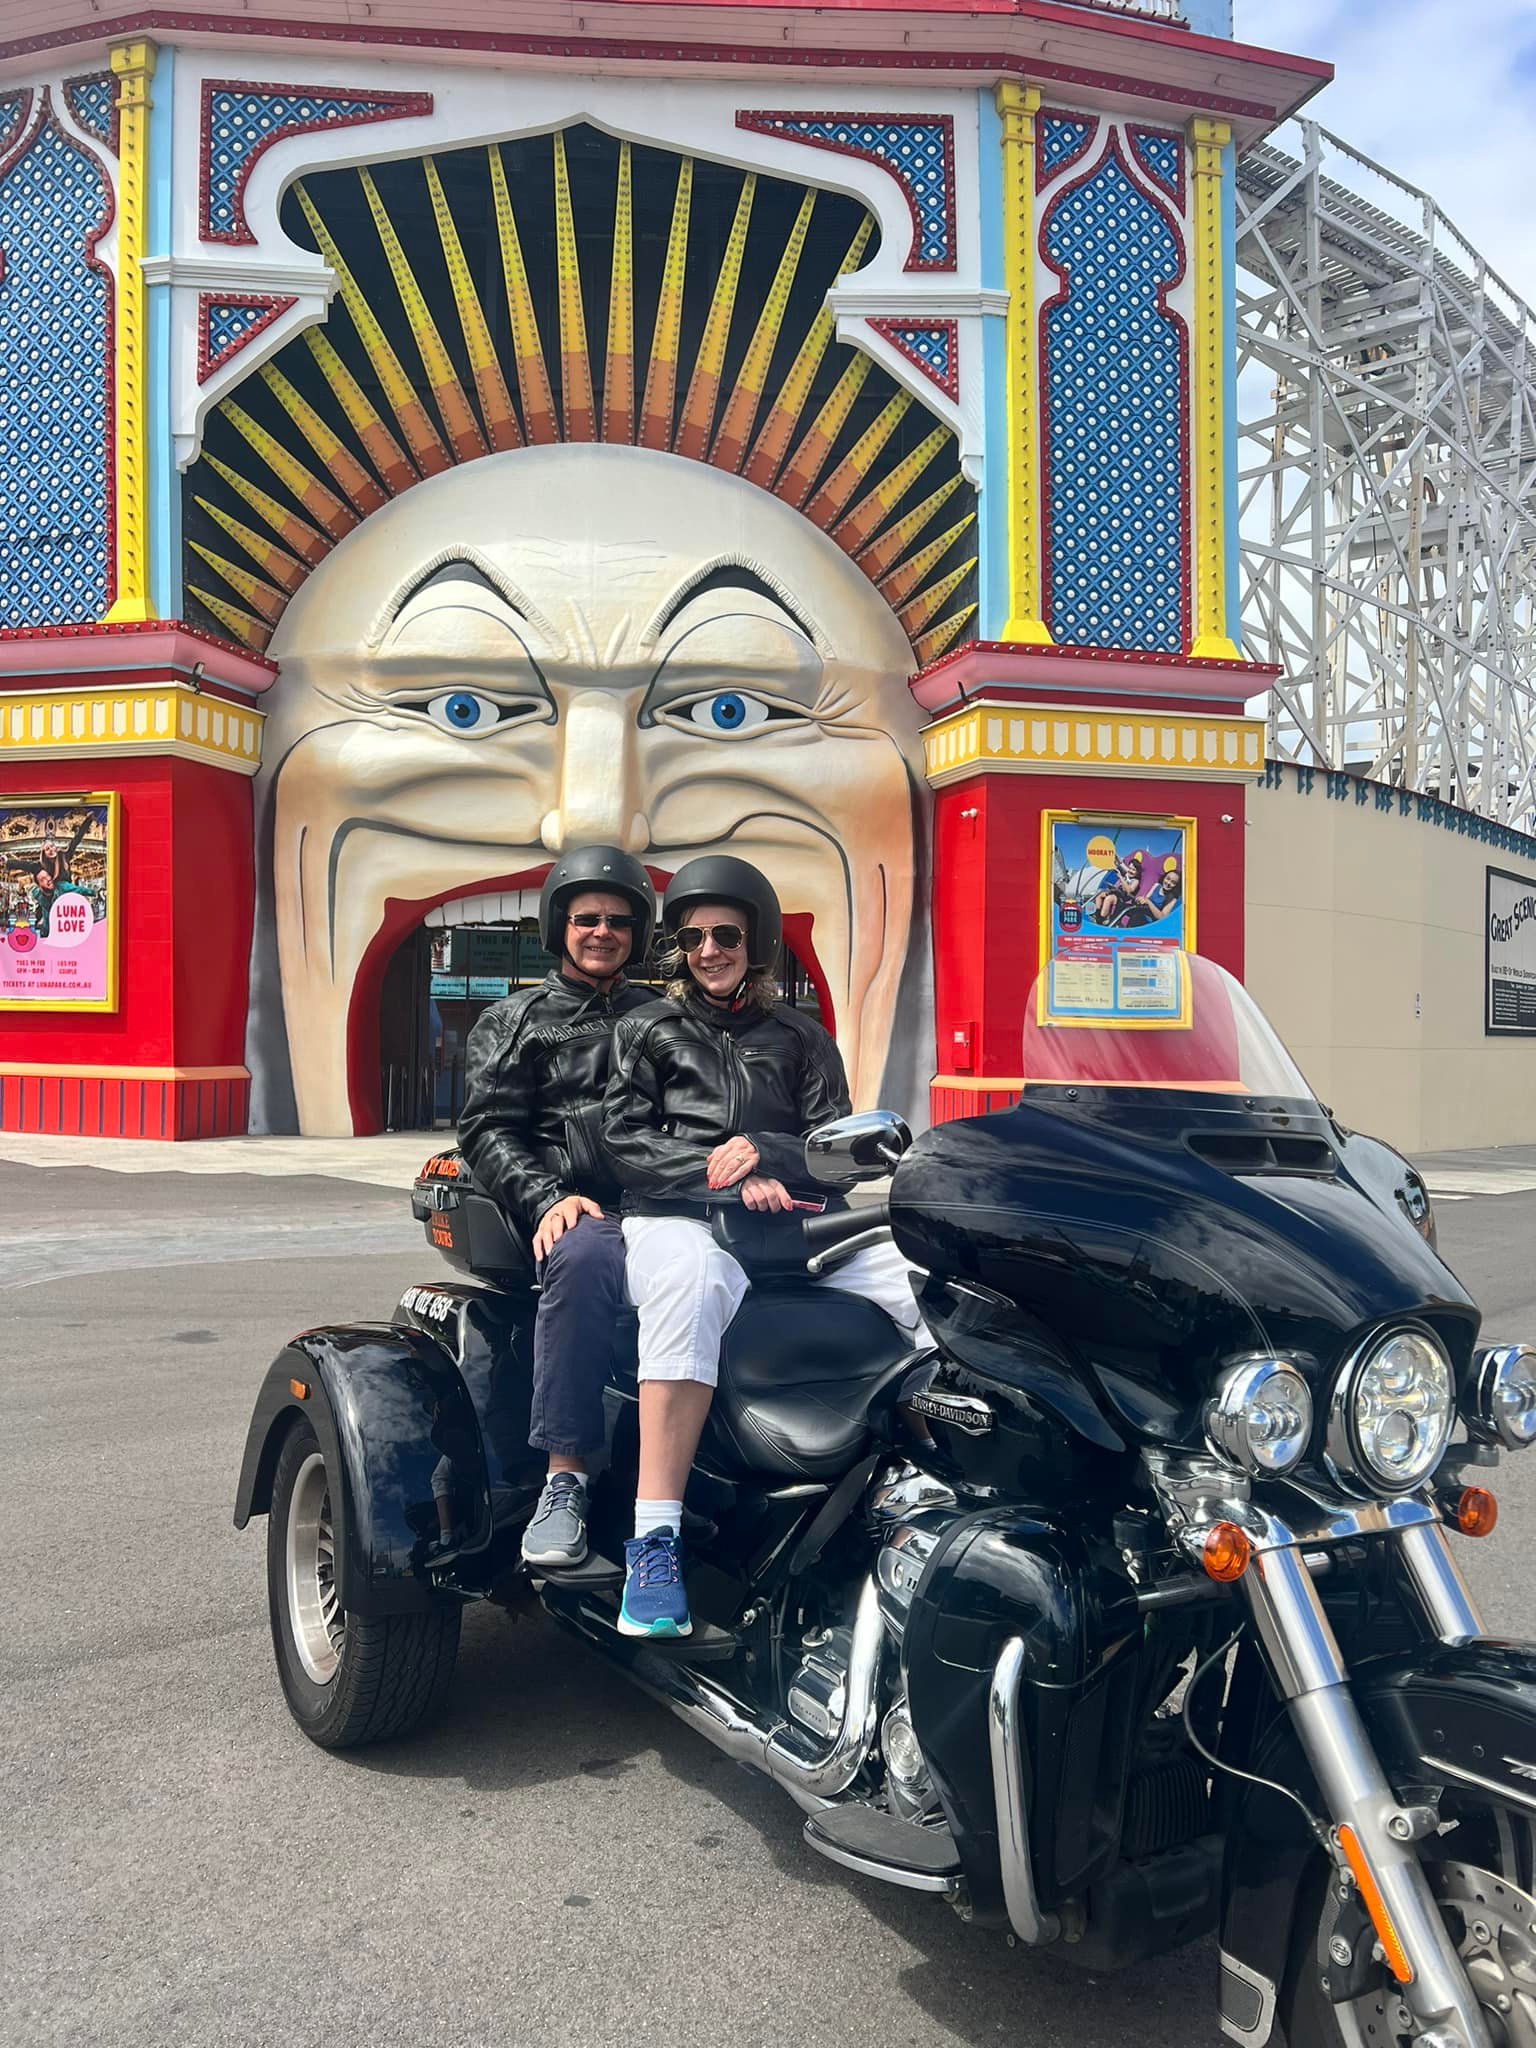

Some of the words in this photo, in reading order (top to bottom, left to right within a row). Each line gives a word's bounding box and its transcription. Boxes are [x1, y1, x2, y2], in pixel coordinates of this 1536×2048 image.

[57, 905, 86, 918] LUNA
[58, 920, 85, 932] LOVE
[1491, 913, 1512, 942] GREAT
[536, 1017, 608, 1047] HARLEY
[429, 1295, 453, 1322] 858
[912, 1394, 989, 1427] HARLEY-DAVIDSON
